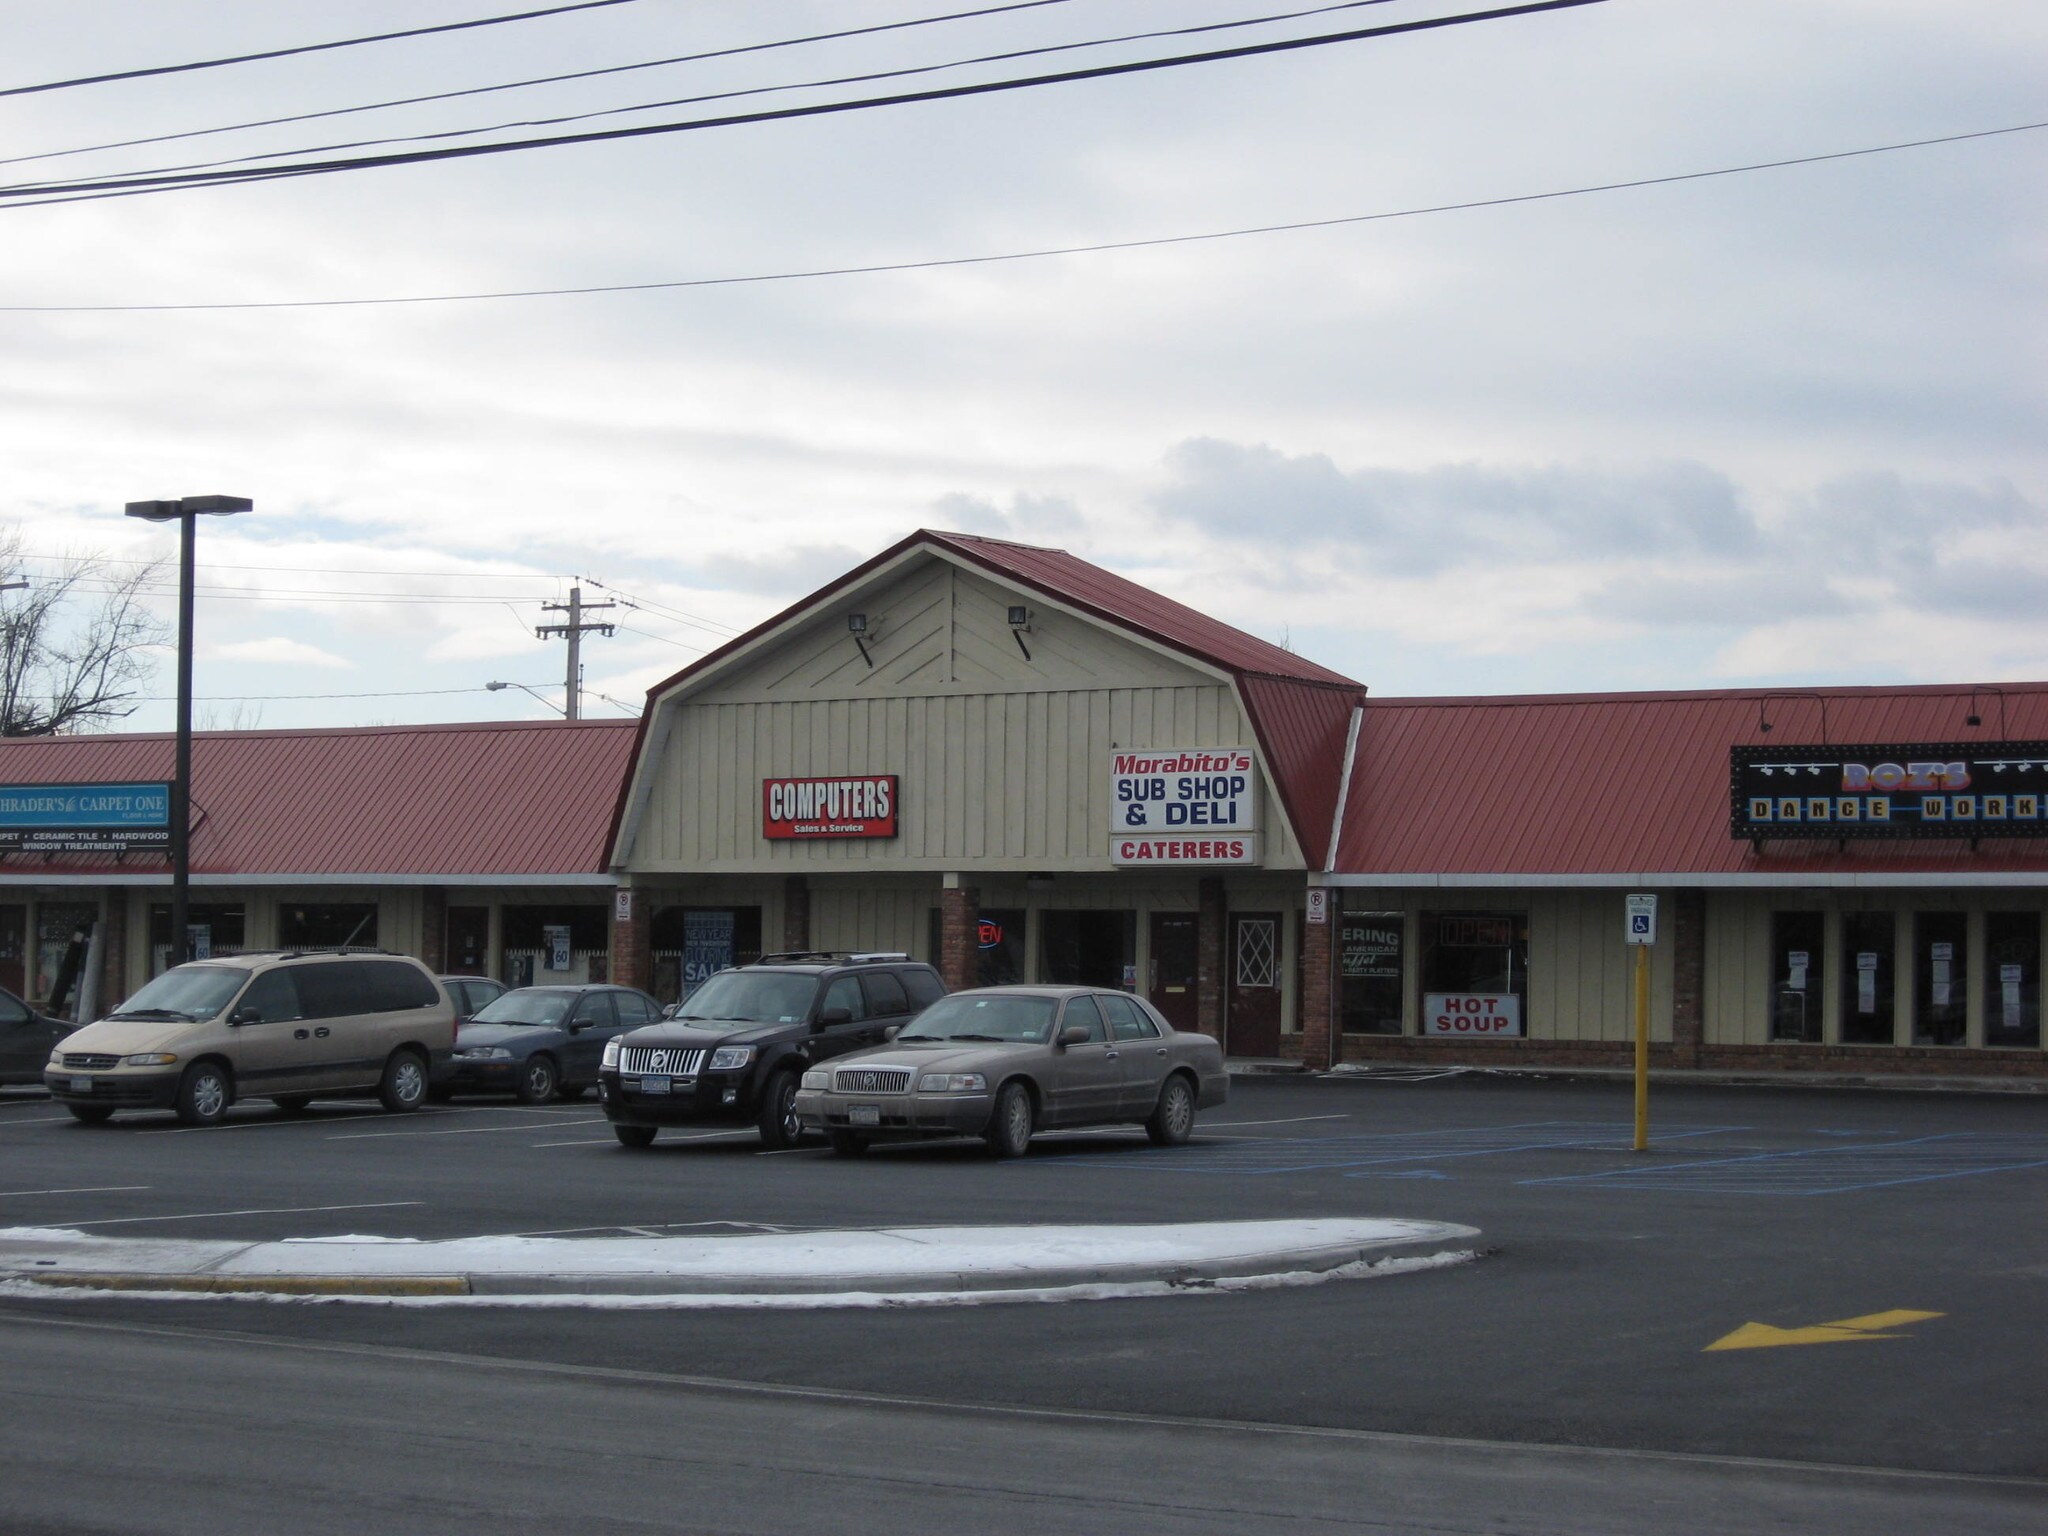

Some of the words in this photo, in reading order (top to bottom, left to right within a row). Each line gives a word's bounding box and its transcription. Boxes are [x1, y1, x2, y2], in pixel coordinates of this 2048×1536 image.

[1113, 752, 1250, 775] Morabito's
[1841, 761, 1971, 791] ROZ'S
[1118, 778, 1166, 801] SUB
[1178, 776, 1245, 800] SHOP
[80, 797, 132, 811] CARPET
[135, 796, 164, 811] ONE
[769, 780, 890, 820] COMPUTERS
[1125, 803, 1147, 826] &
[1166, 801, 1237, 825] DELI
[1754, 800, 1884, 818] DANCE
[33, 832, 75, 840] CERAMIC
[794, 824, 820, 833] Sales
[829, 824, 864, 832] Service
[22, 842, 62, 850] WINDOW
[65, 842, 127, 850] TREATMENTS
[1120, 841, 1244, 860] CATERERS
[686, 928, 706, 940] NEW
[707, 928, 732, 940] YEAR
[555, 950, 568, 962] 60
[1346, 945, 1398, 953] AMERICAN
[1445, 998, 1498, 1014] HOT
[1436, 1016, 1509, 1032] SOUP
